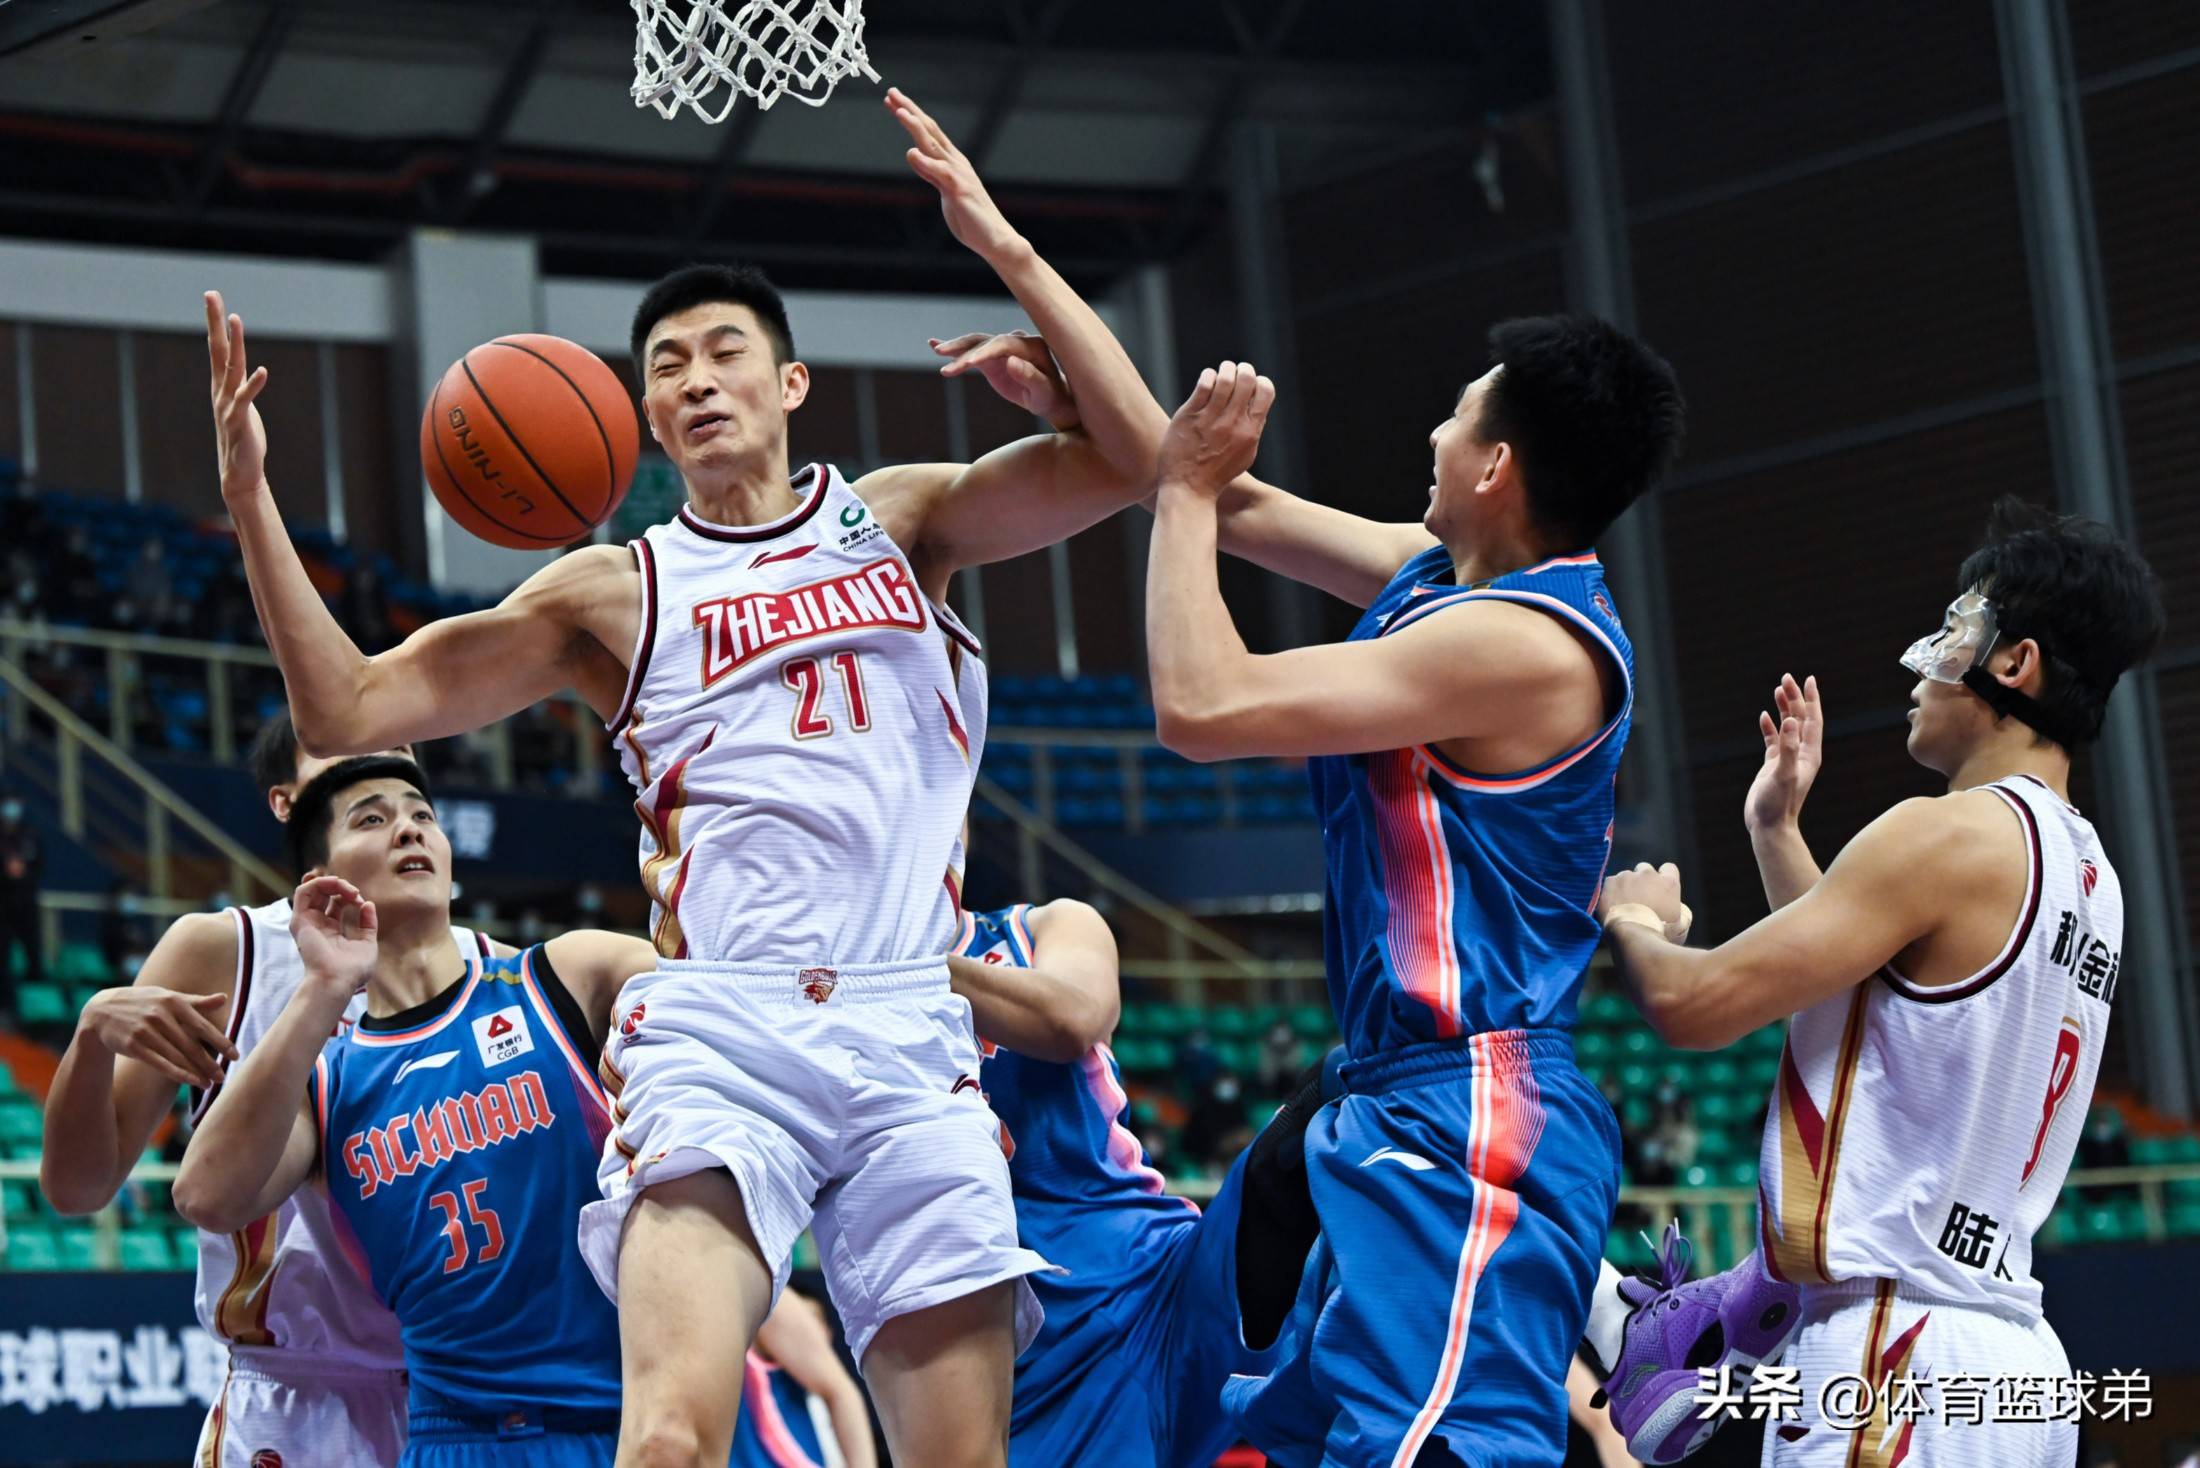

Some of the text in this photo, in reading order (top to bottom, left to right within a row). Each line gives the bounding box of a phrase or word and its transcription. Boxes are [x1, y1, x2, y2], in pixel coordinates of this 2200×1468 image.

[448, 406, 536, 516] LI-NING
[843, 537, 868, 552] CHINA
[694, 557, 926, 688] ZHEJIANG
[780, 650, 872, 741] 21
[497, 1046, 519, 1061] CGB
[342, 1070, 556, 1201] SICHUAN
[428, 1177, 505, 1275] 35
